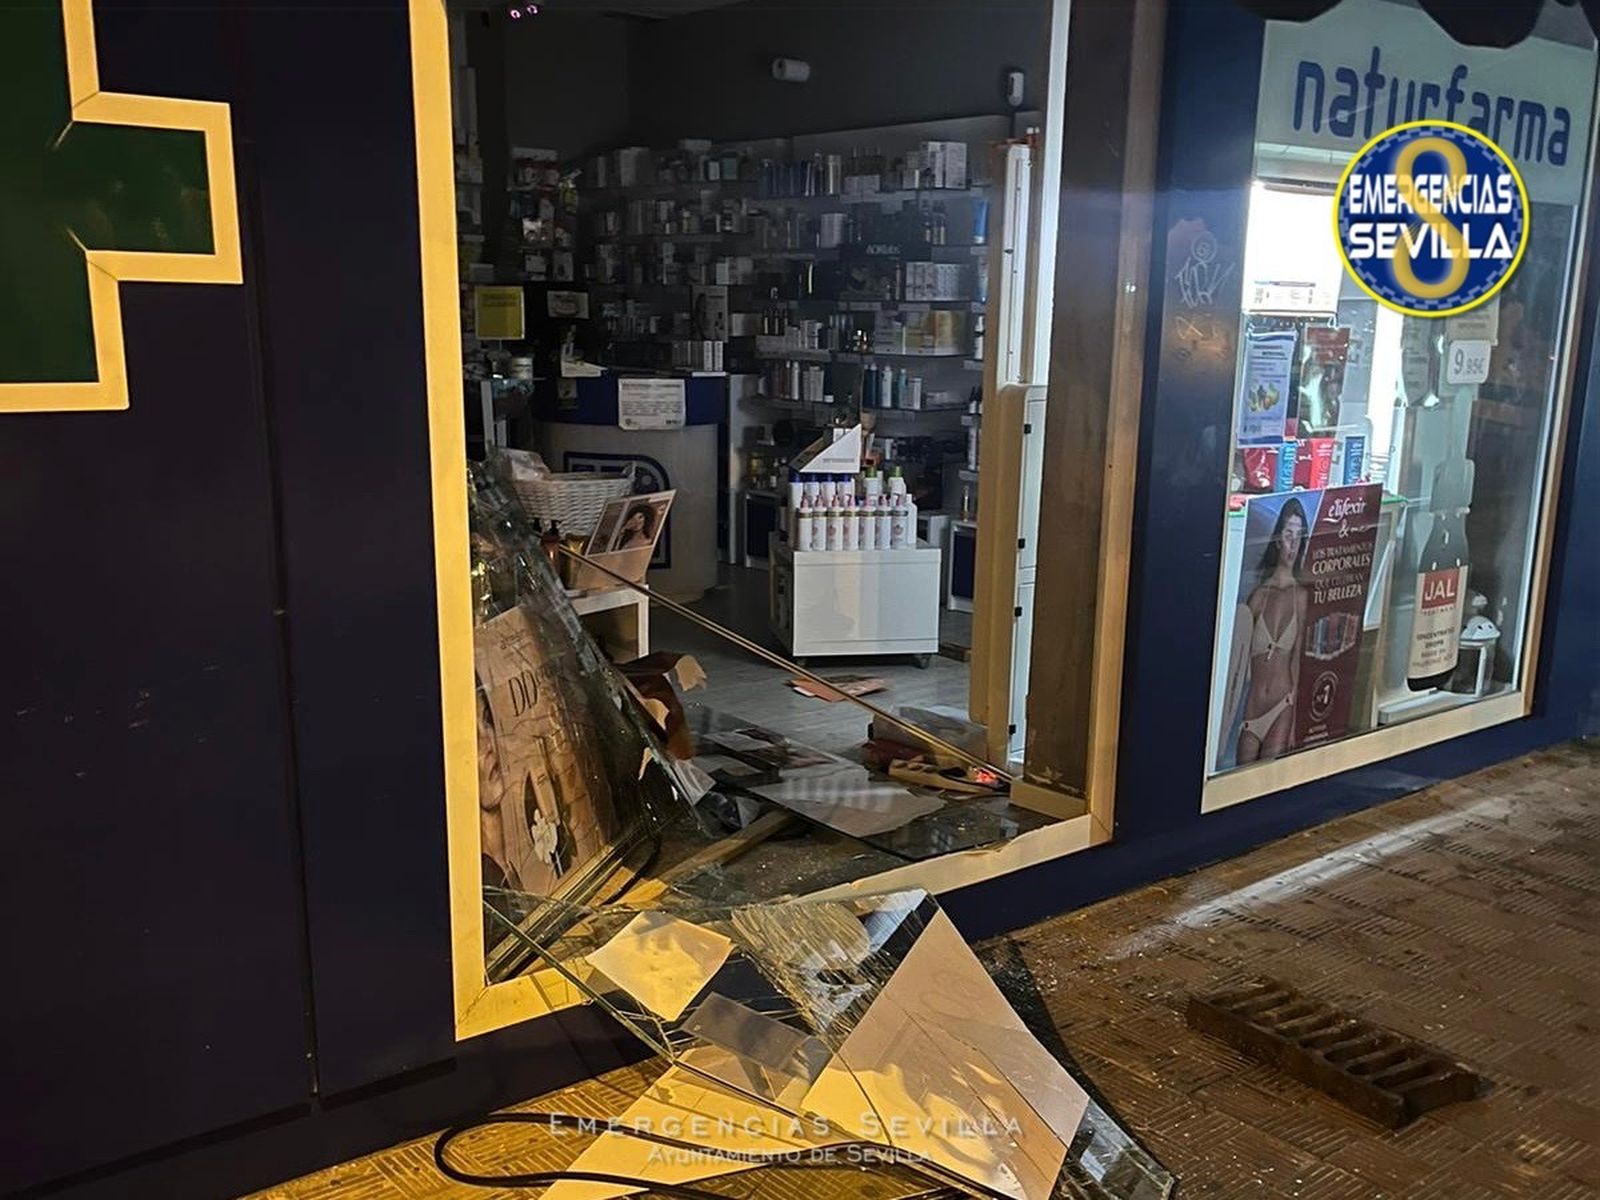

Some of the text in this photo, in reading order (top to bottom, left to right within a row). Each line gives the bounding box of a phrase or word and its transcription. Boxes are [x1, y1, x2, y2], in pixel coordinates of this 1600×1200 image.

[1293, 46, 1571, 167] naturfarma
[1311, 553, 1371, 575] CORPORALES
[1314, 583, 1363, 605] TU BELLEZA
[1423, 578, 1456, 602] JAL
